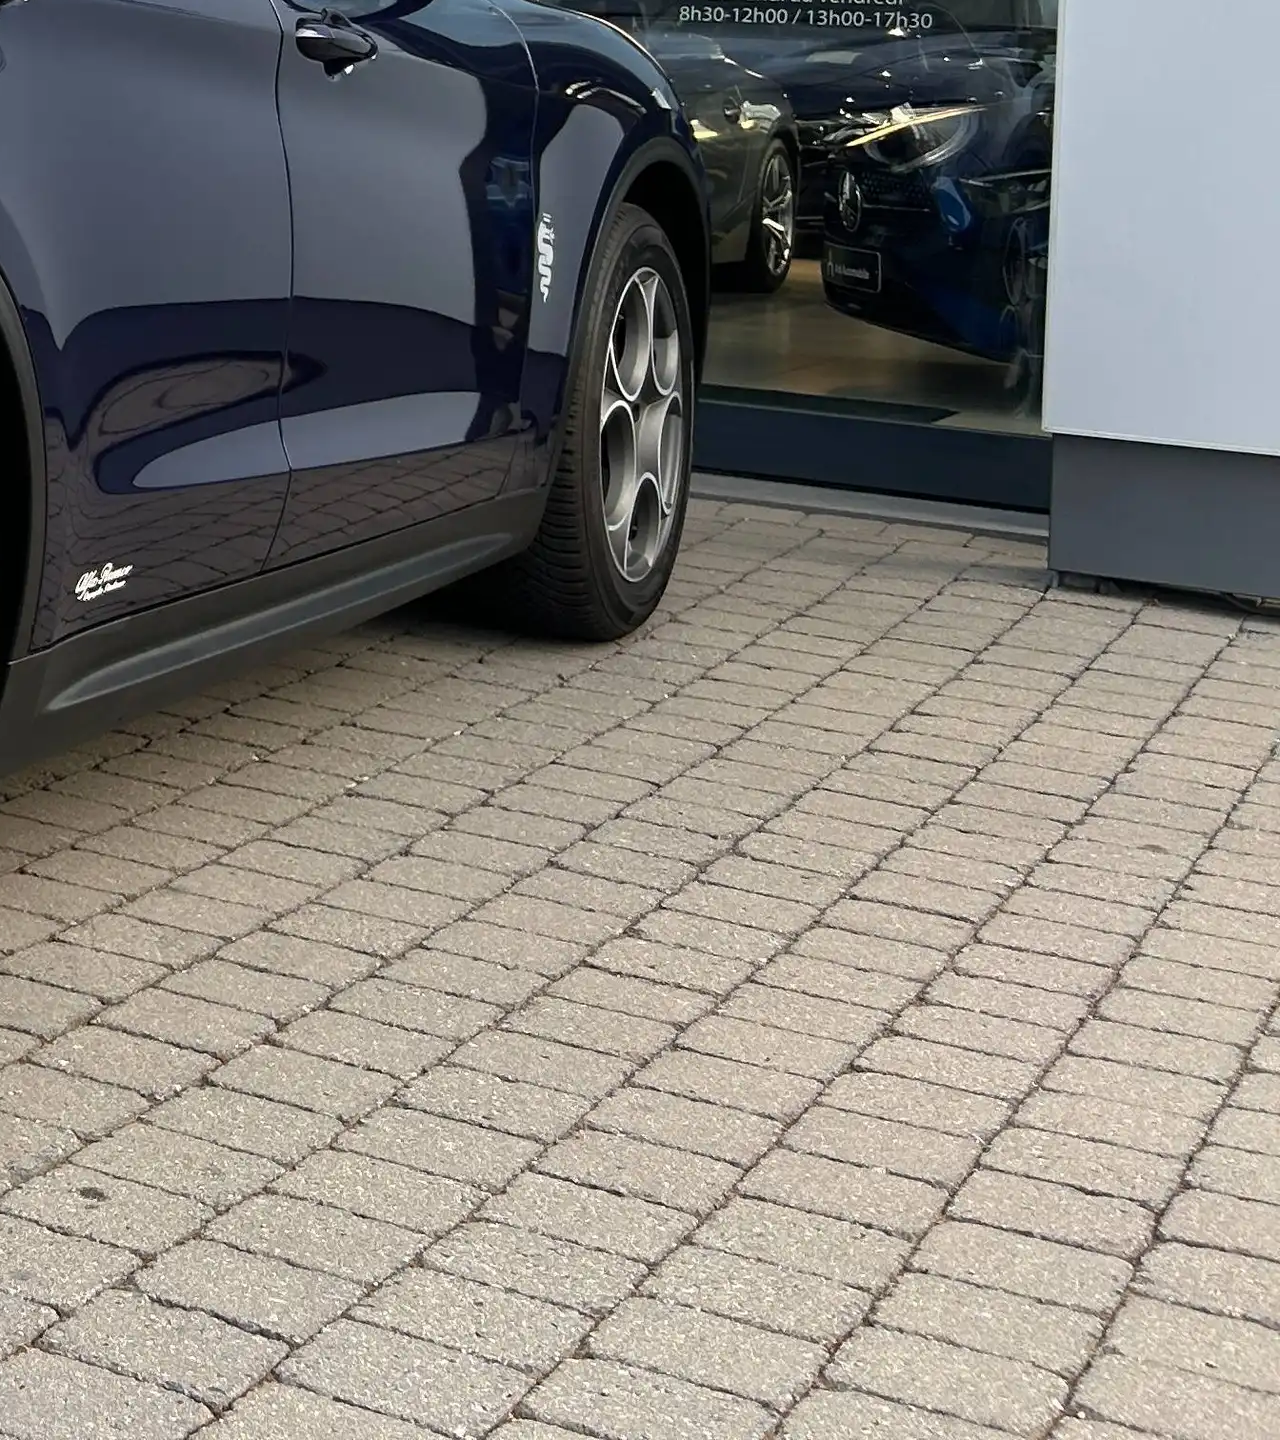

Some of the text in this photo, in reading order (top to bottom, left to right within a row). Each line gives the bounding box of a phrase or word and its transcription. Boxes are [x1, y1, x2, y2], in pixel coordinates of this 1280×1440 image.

[679, 6, 933, 29] 8h30-12h00 / 13h00-17h30
